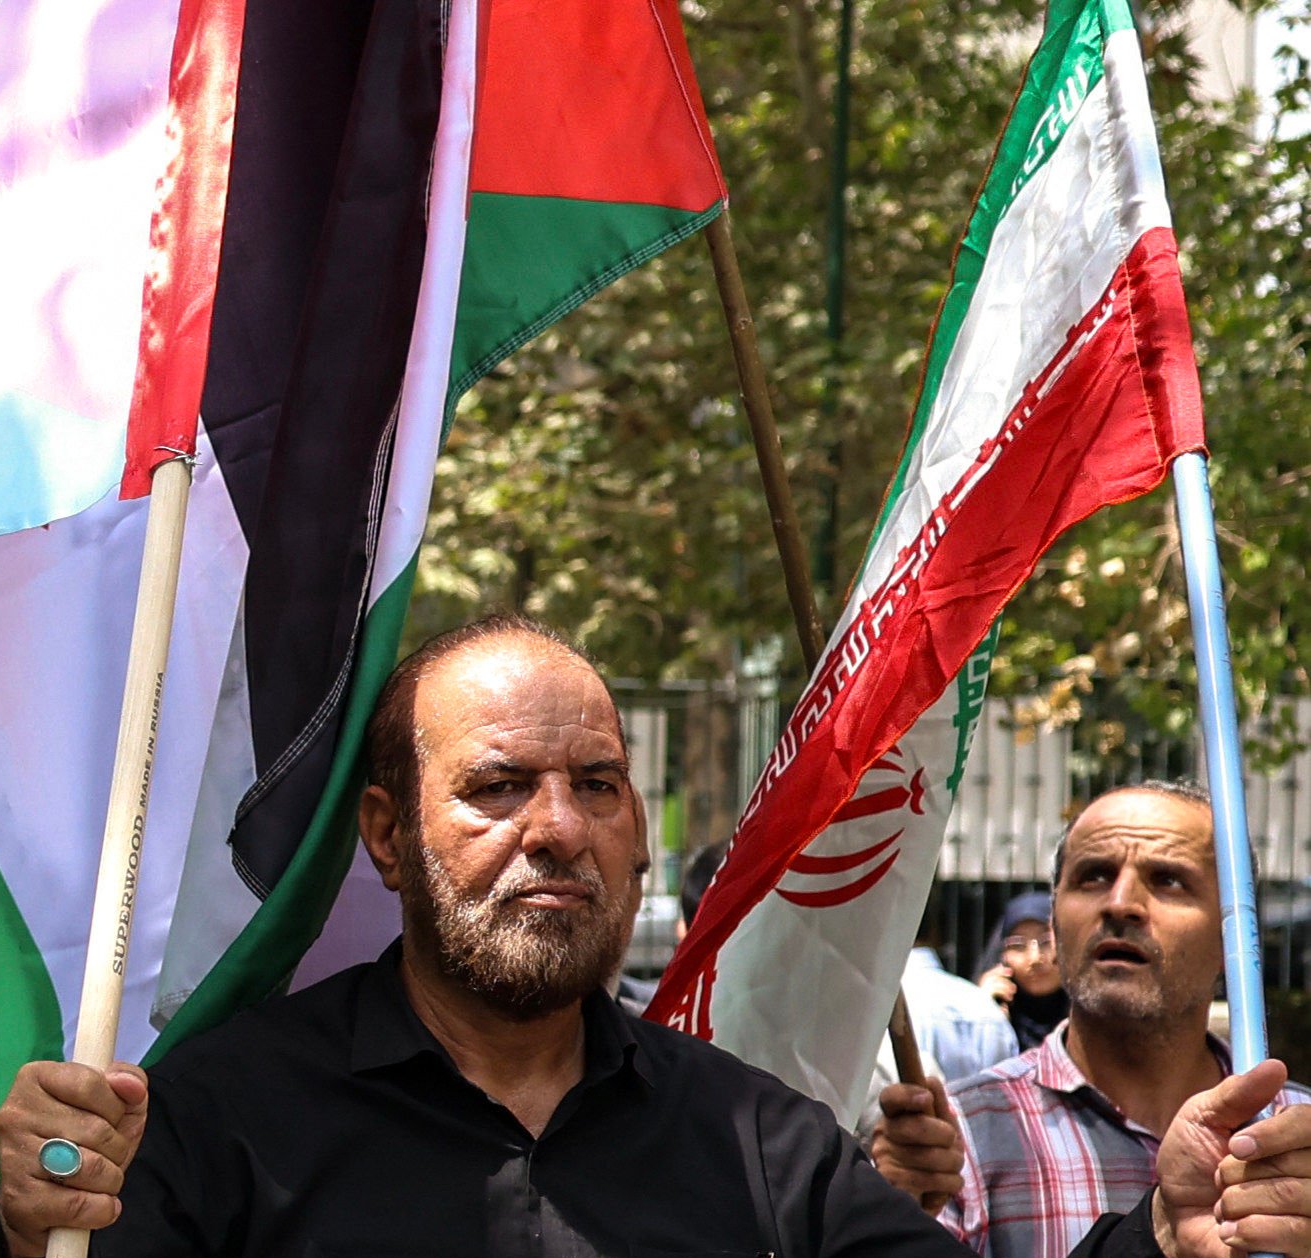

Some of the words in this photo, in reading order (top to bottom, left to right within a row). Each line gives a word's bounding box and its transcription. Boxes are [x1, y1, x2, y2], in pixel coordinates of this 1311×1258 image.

[150, 672, 164, 733] RUSSIA
[147, 737, 155, 754] IN
[140, 760, 152, 808] MADE
[113, 815, 145, 976] SUPERWOOD
